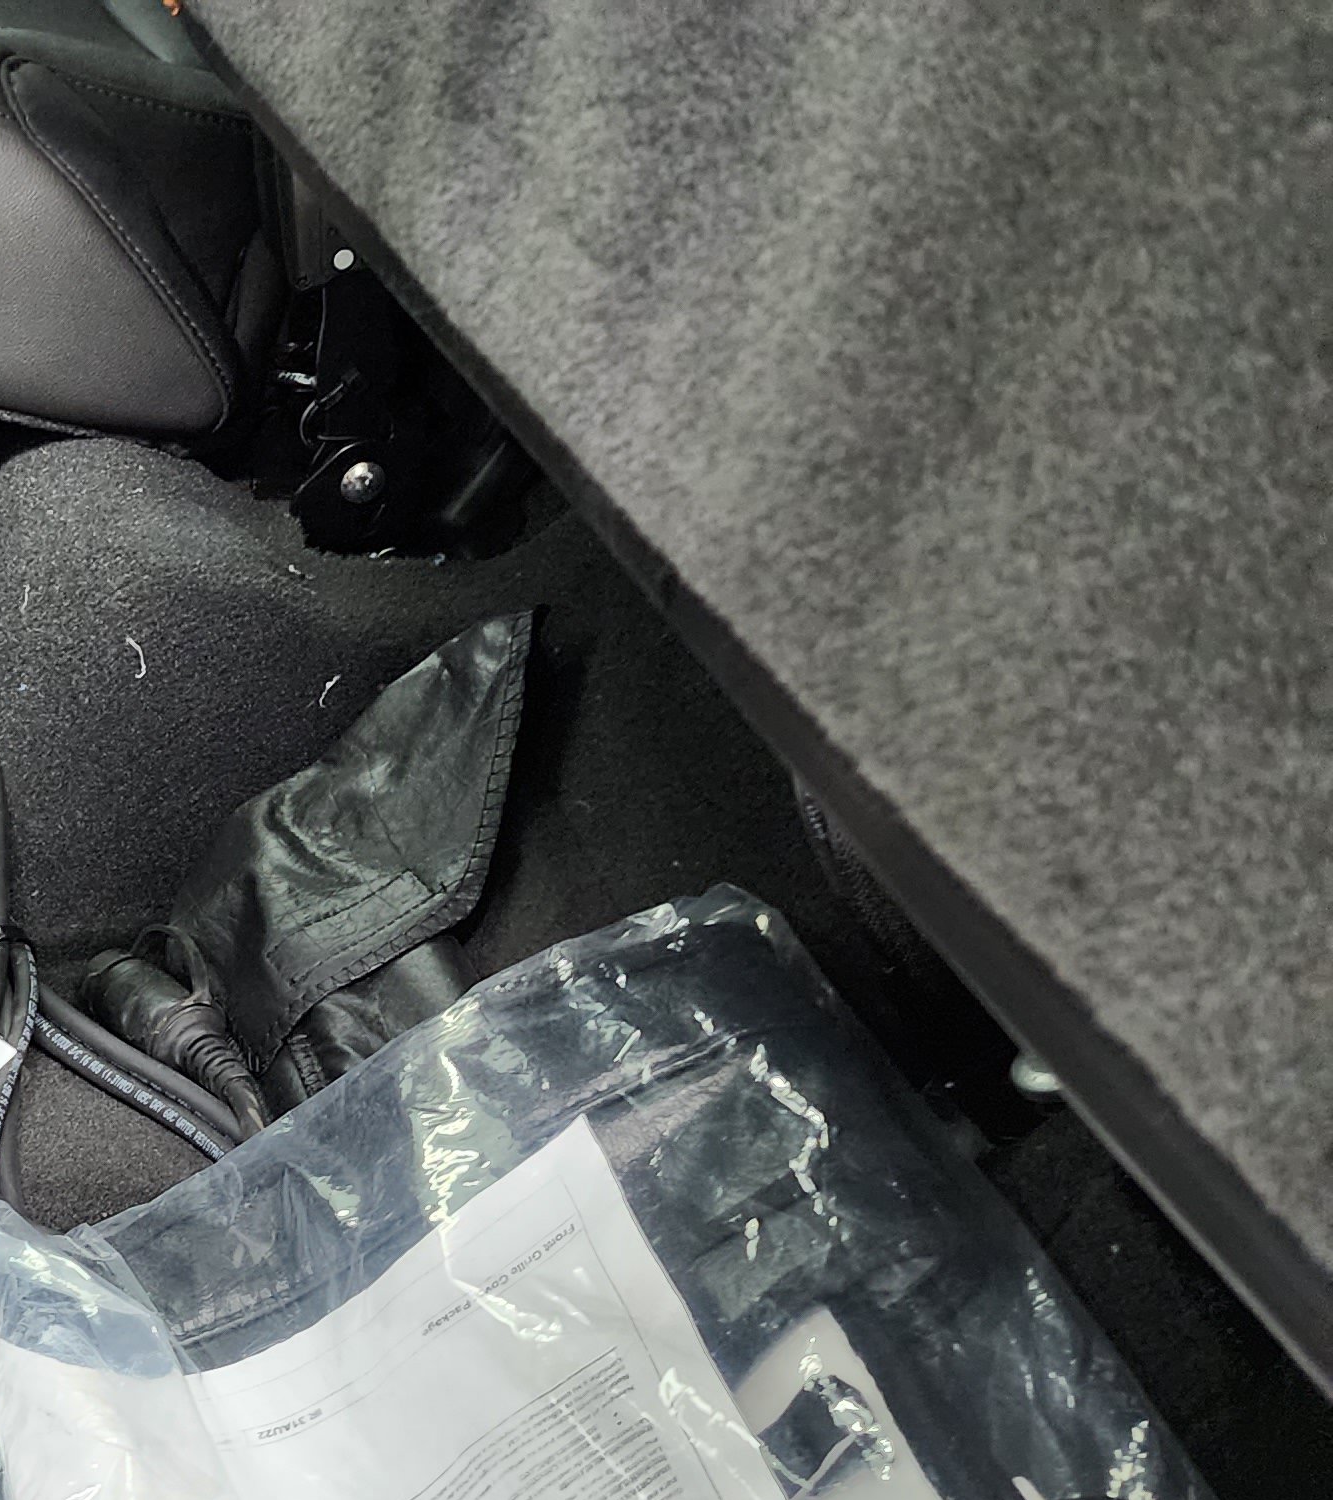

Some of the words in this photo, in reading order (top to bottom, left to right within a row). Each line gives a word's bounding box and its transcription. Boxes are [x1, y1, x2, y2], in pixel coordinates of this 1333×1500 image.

[150, 1099, 164, 1113] DRY
[543, 1223, 575, 1252] Front
[510, 1250, 542, 1275] Grille
[422, 1300, 472, 1337] Package
[256, 1416, 307, 1441] 31AU22
